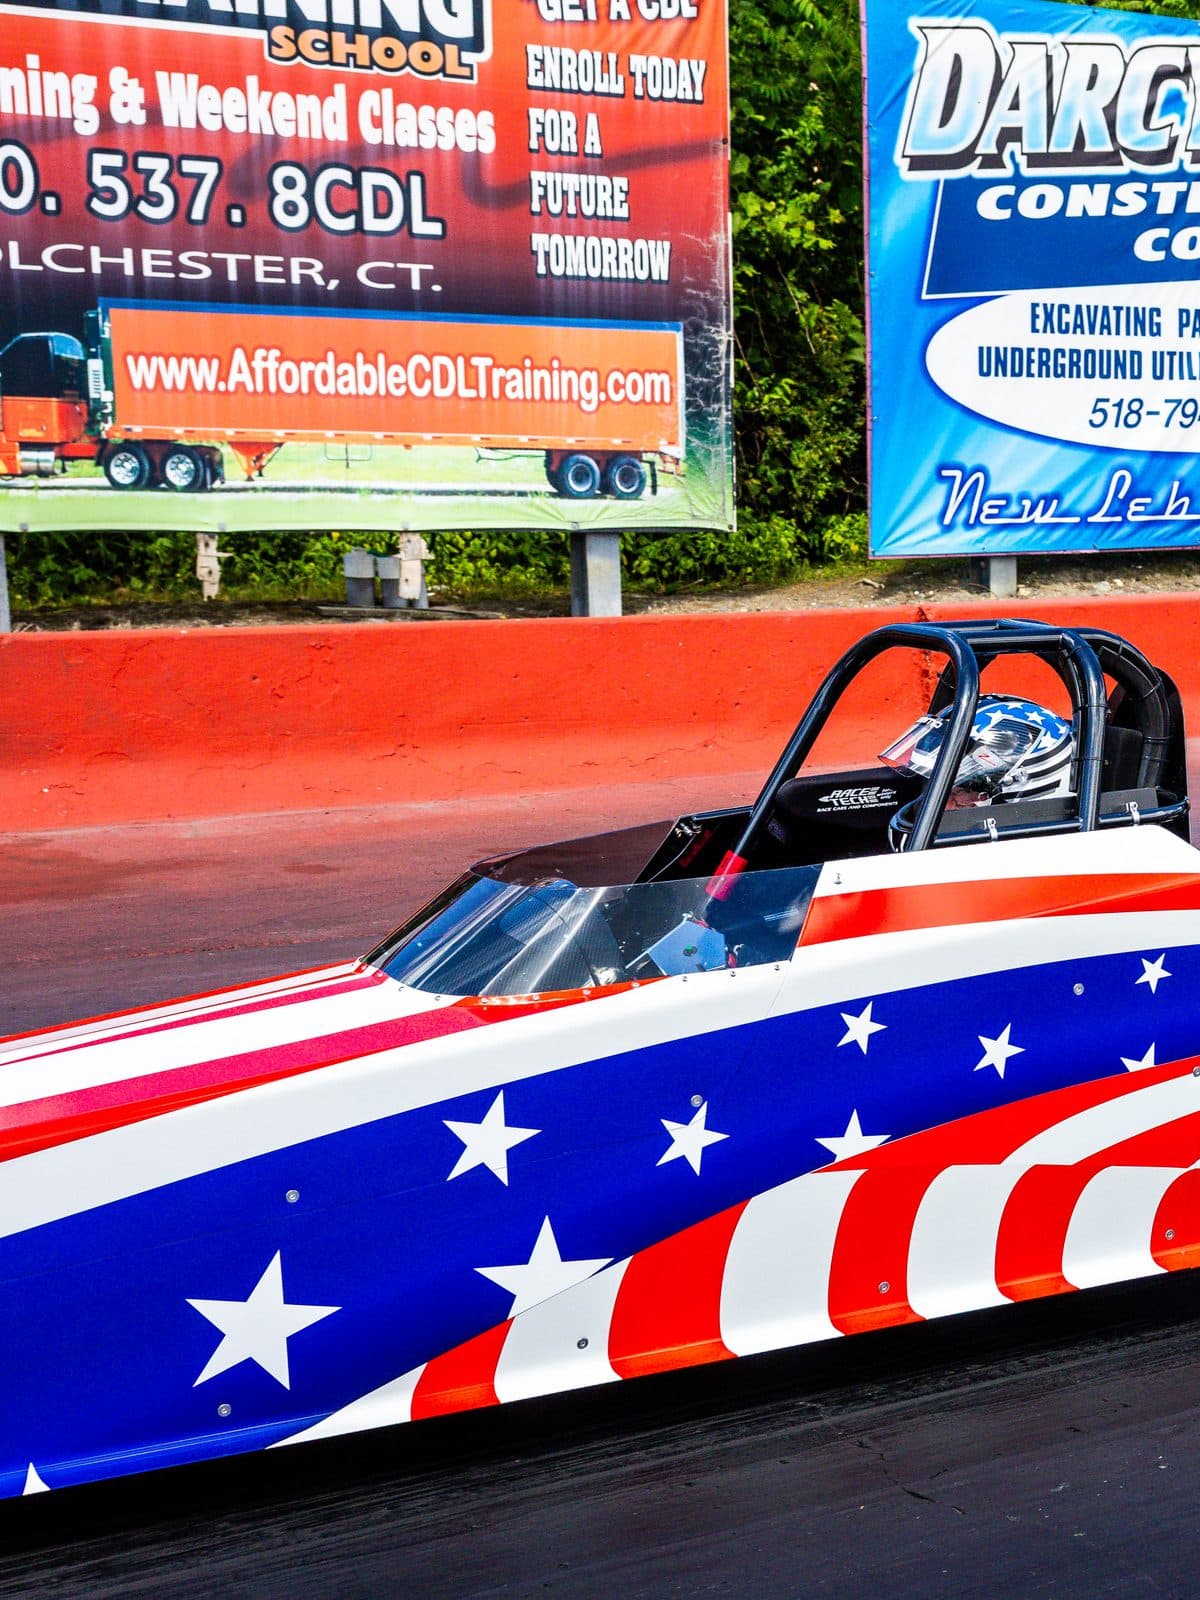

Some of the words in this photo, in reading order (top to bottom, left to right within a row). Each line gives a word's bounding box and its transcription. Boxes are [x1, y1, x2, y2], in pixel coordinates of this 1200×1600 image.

[270, 24, 473, 78] SCHOOL
[525, 43, 625, 97] ENROLL
[628, 53, 707, 102] TODAY
[0, 54, 100, 137] ning
[109, 66, 147, 126] &
[156, 71, 348, 142] Weekend
[358, 87, 497, 155] Classes
[527, 106, 579, 155] FOR
[584, 111, 604, 158] A
[271, 164, 444, 237] 8CDL
[529, 170, 630, 220] FUTURE
[0, 240, 340, 291] LCHESTER,
[356, 260, 443, 292] CT.
[530, 232, 672, 283] TOMORROW
[1030, 302, 1162, 337] EXCAVATING
[126, 347, 672, 411] www.AffordableCDLTraining.com
[978, 345, 1143, 381] UNDERGROUND
[941, 469, 1080, 525] New
[830, 787, 872, 799] RACE
[830, 796, 870, 807] TECH
